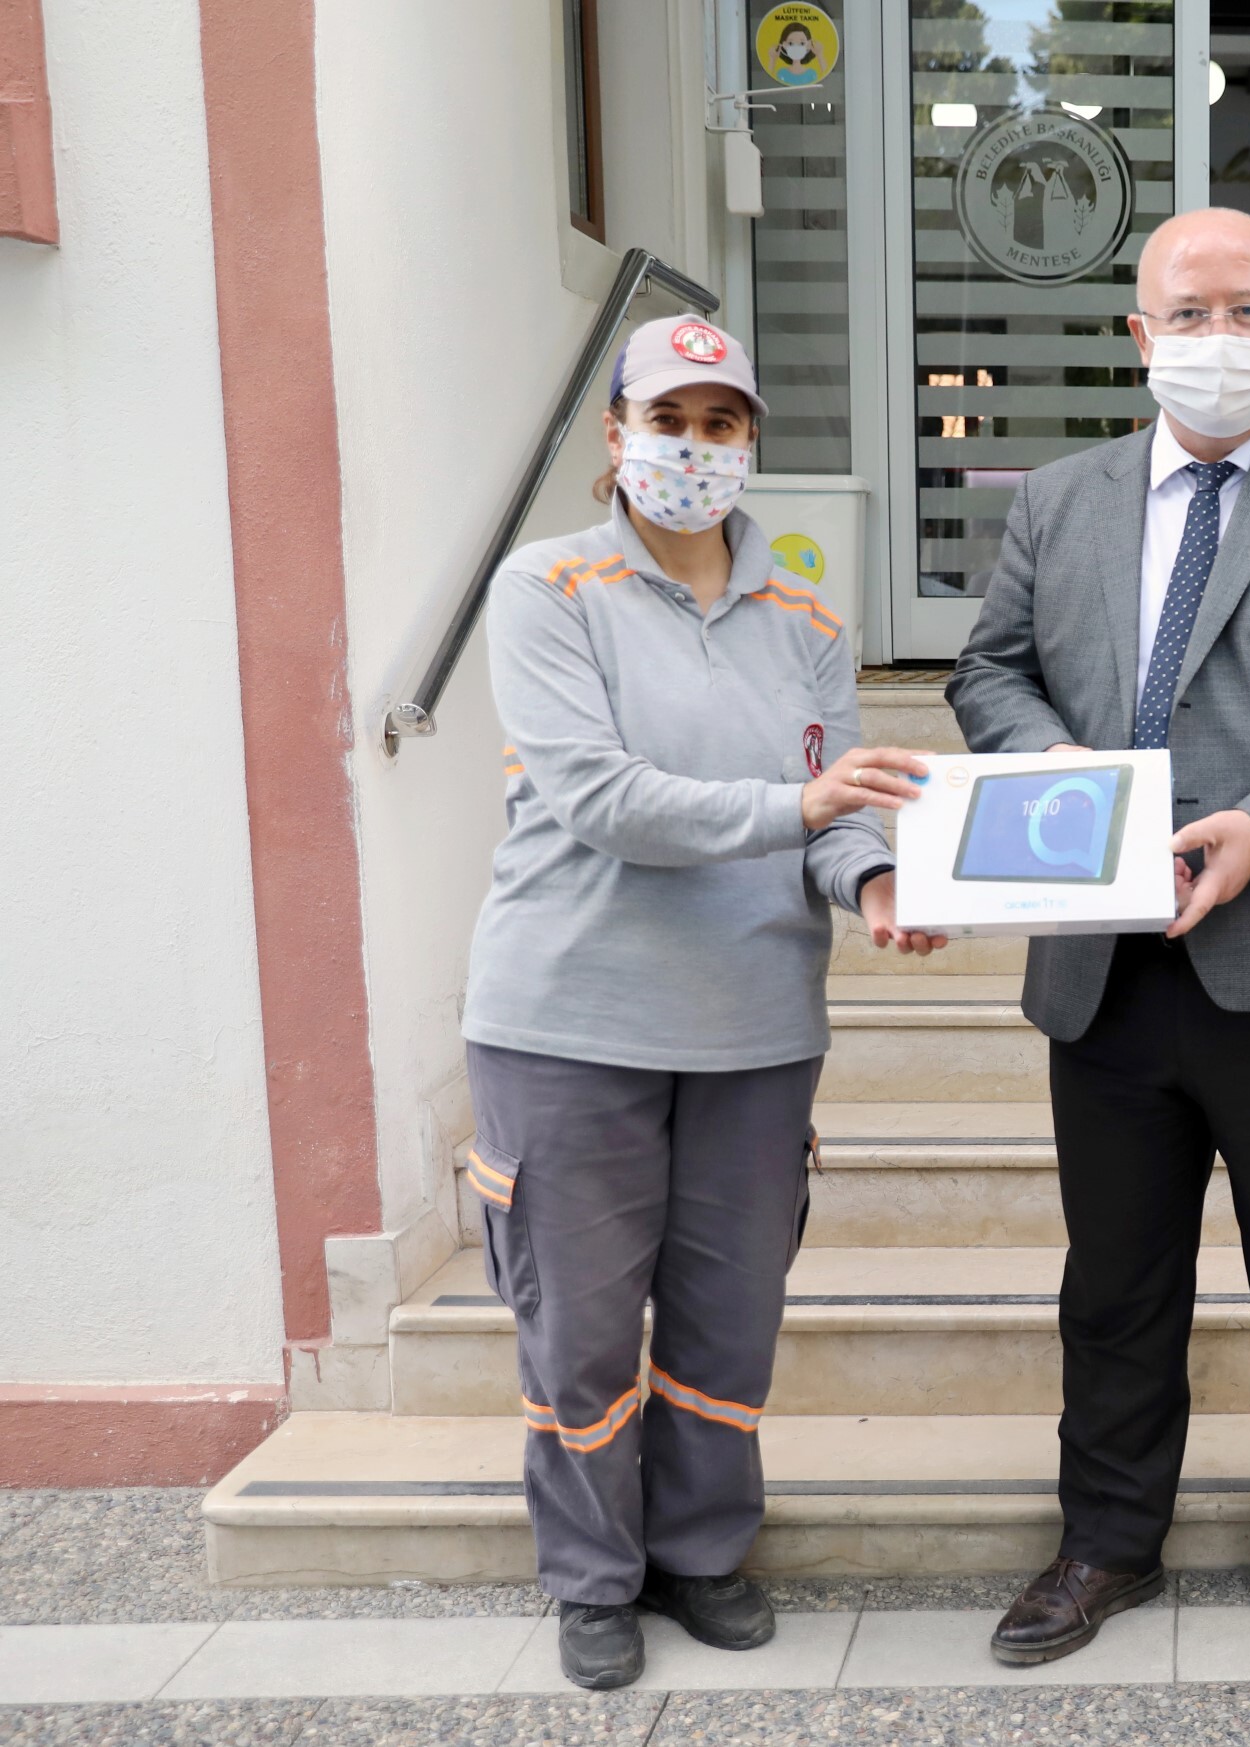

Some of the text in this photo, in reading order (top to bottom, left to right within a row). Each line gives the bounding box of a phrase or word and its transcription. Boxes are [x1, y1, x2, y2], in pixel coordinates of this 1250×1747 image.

[975, 123, 1111, 182] BELEDİYE BAŞKANLIĞI
[1005, 247, 1082, 268] MENTEŞE
